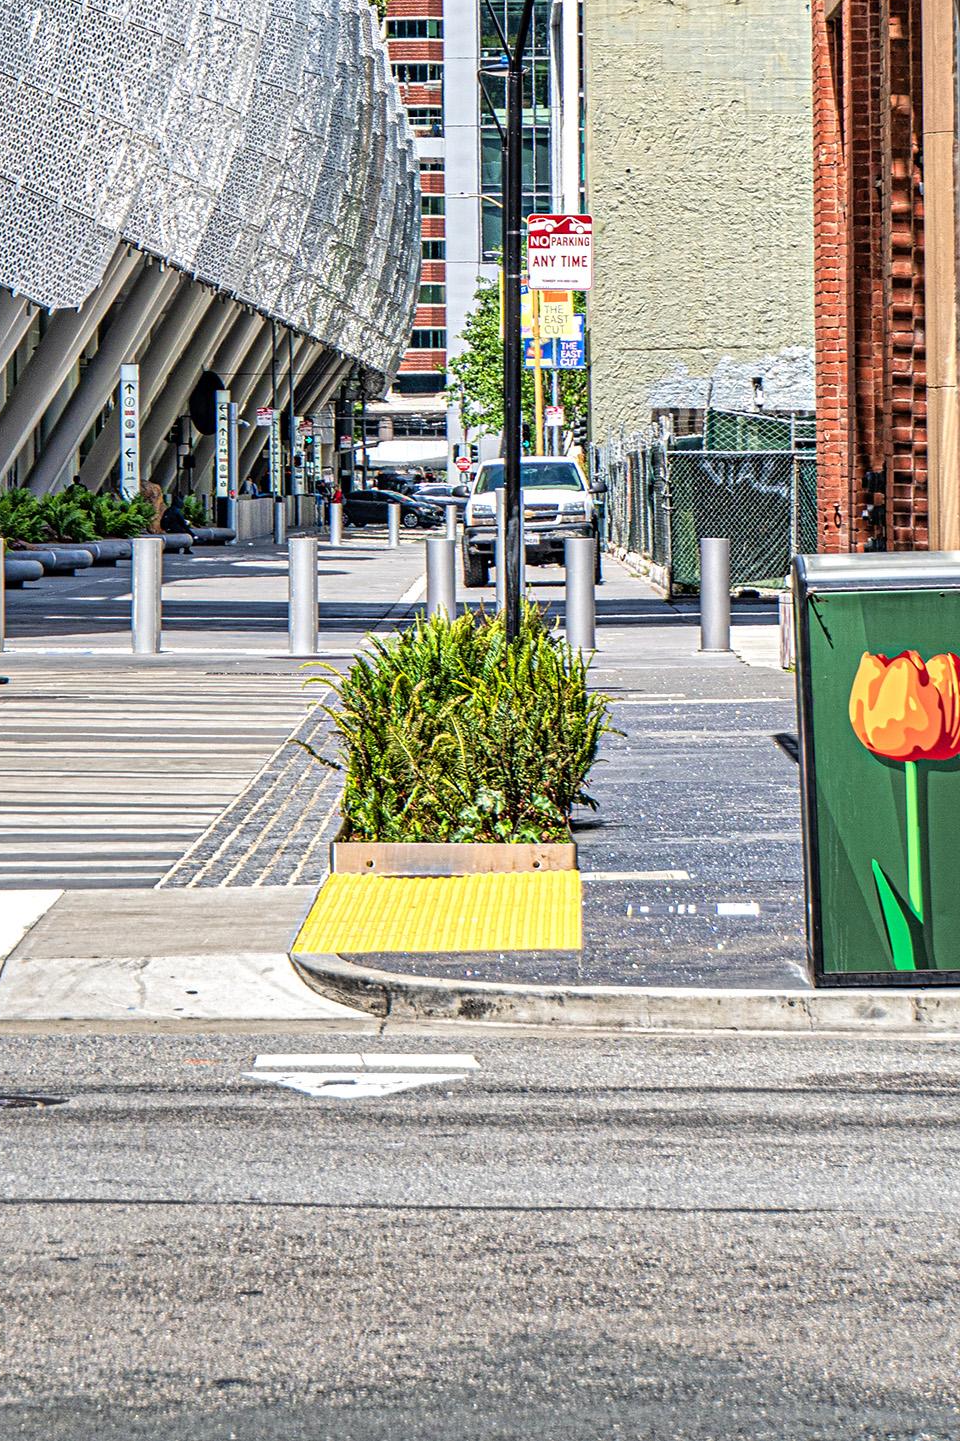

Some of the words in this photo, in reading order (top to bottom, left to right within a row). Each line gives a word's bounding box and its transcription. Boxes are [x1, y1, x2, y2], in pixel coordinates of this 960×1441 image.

[530, 236, 550, 247] NO
[551, 237, 590, 247] PARKING
[532, 255, 556, 267] ANY
[561, 255, 588, 267] TIME
[544, 305, 564, 314] THE
[544, 315, 569, 324] EAST
[544, 325, 564, 334] CUT
[560, 350, 582, 358] EAST
[560, 358, 578, 366] CUT
